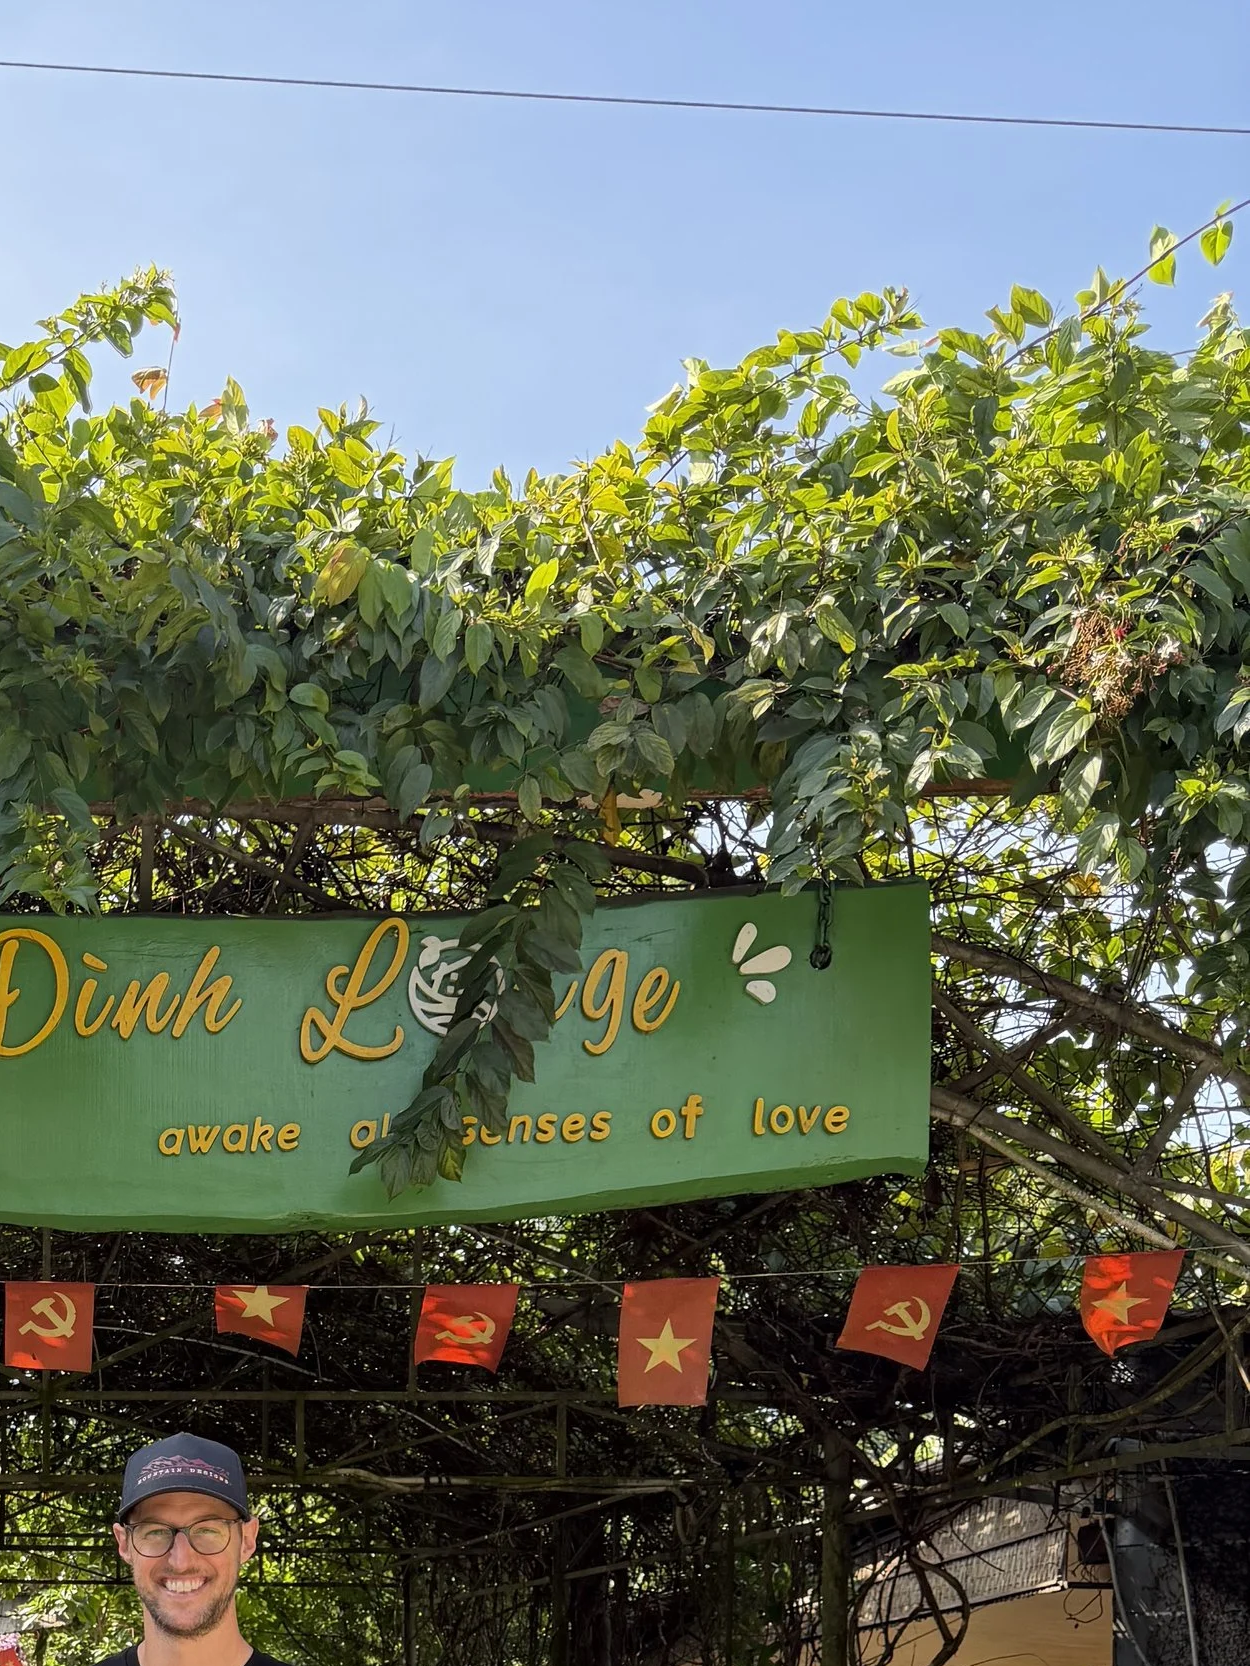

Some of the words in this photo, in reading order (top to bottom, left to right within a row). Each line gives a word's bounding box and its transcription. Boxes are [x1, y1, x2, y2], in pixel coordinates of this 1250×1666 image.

[300, 916, 681, 1065] Lge
[158, 1116, 301, 1156] awake
[350, 1112, 402, 1150] al
[651, 1094, 704, 1139] of
[754, 1097, 851, 1135] love
